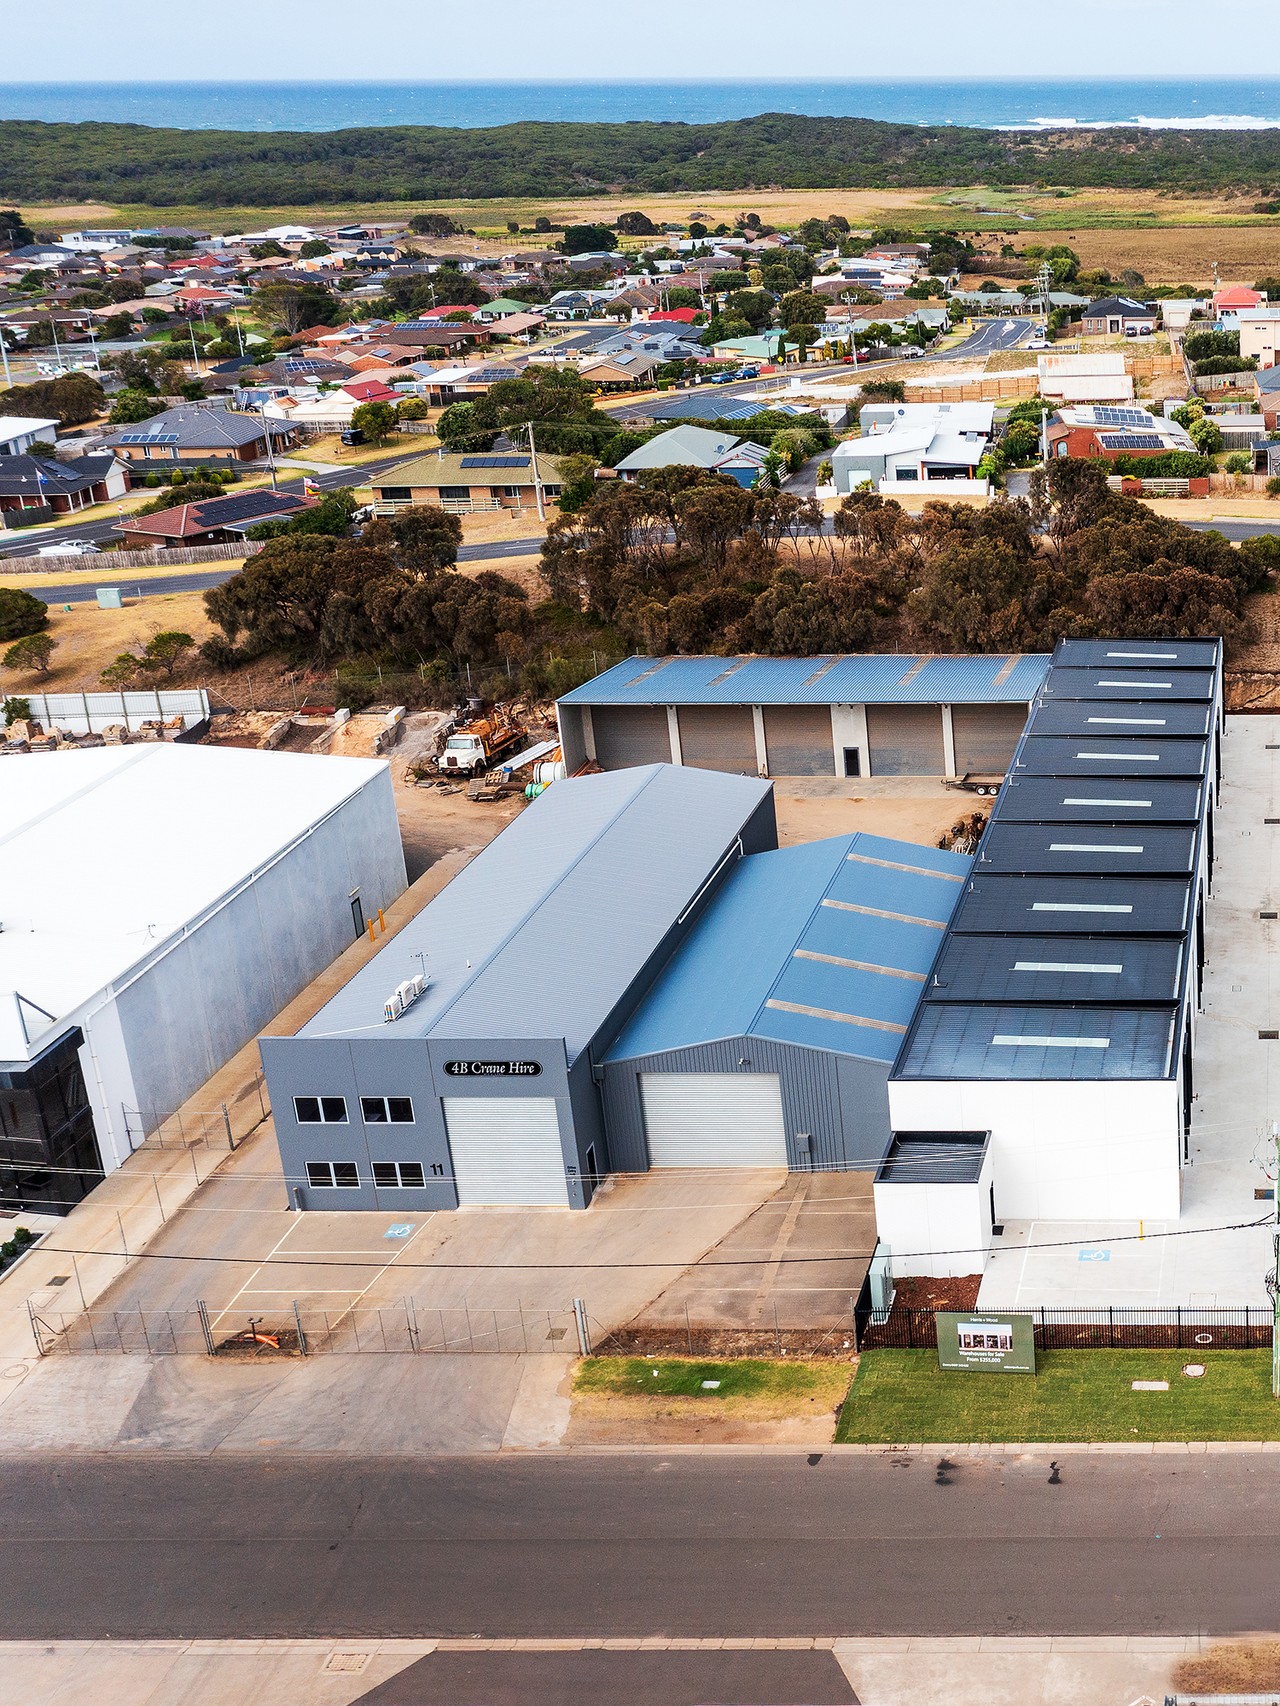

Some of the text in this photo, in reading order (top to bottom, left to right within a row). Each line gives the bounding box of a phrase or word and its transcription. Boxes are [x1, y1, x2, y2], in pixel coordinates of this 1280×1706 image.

[451, 1062, 535, 1074] 4B Crane Hire
[430, 1164, 444, 1176] 11
